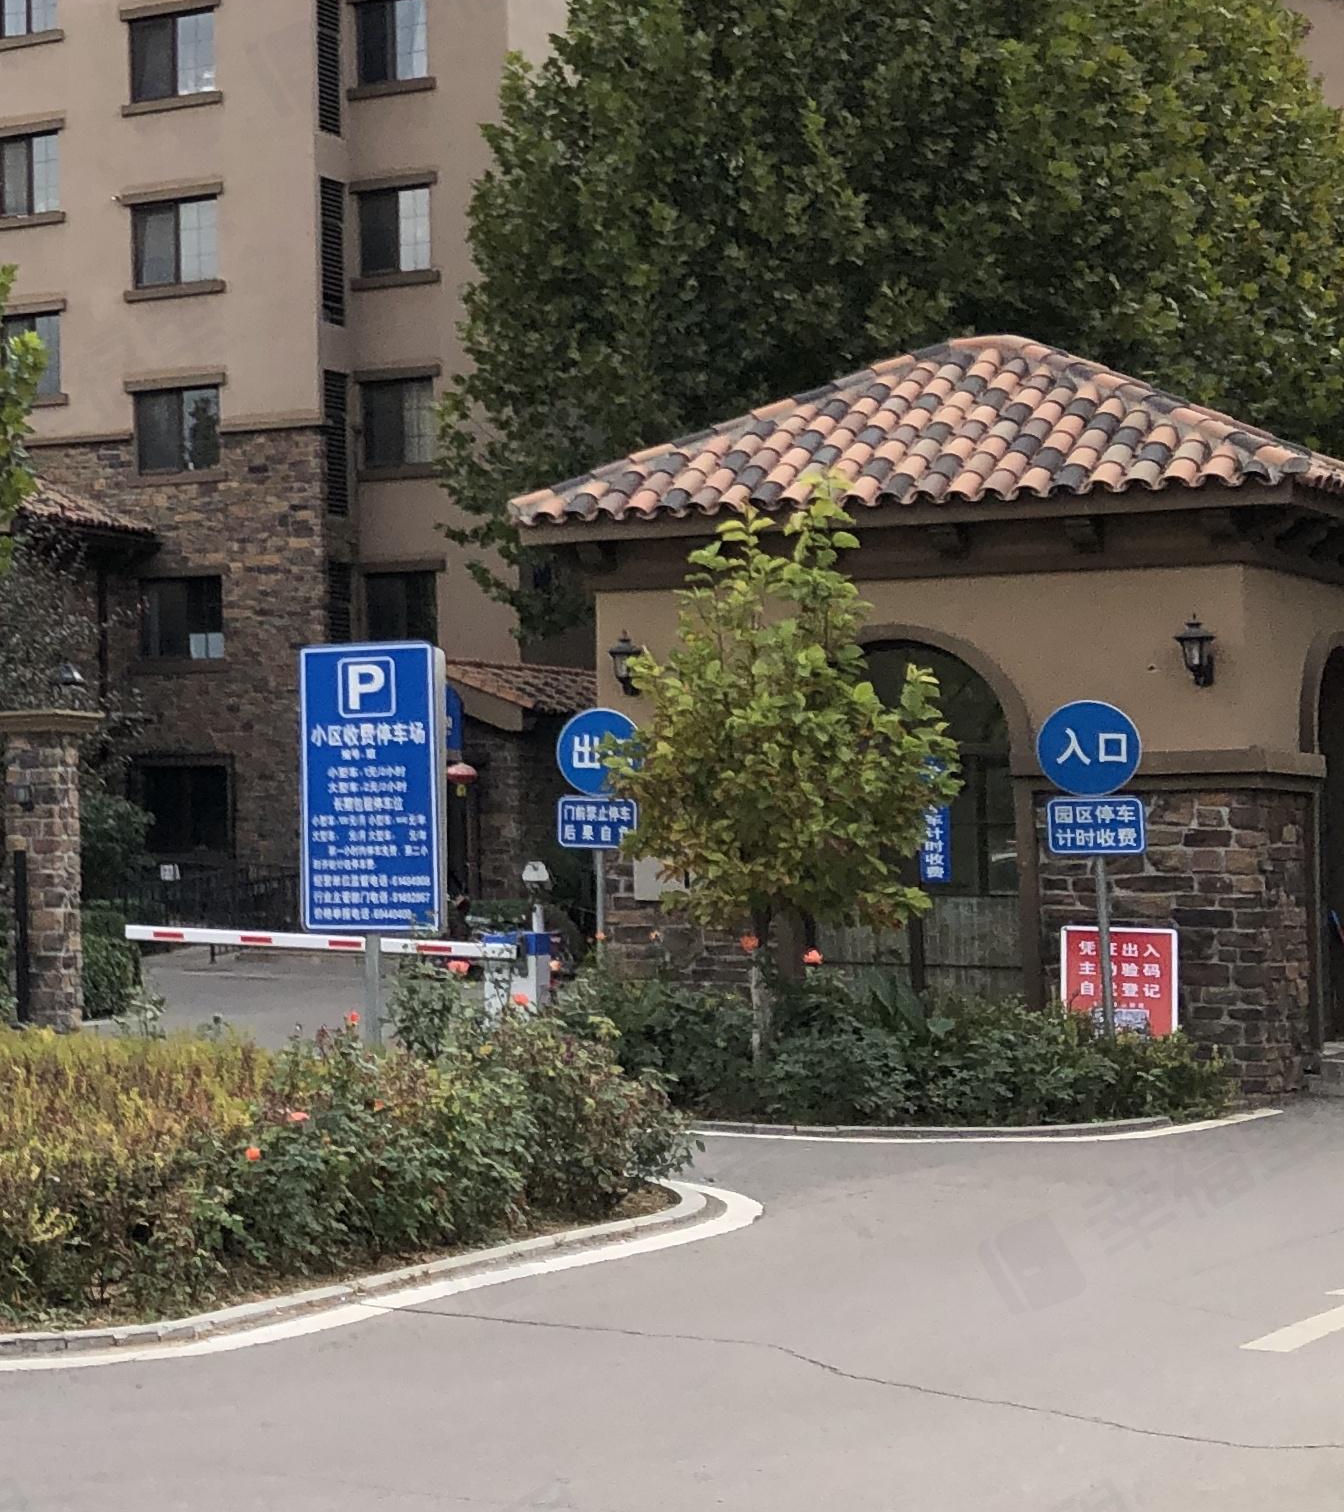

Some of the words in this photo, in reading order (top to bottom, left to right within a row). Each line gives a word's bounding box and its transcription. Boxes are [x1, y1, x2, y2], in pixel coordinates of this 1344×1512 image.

[349, 664, 384, 709] P
[311, 721, 425, 747] 小区收费停车场
[1056, 728, 1127, 765] 入口
[564, 804, 632, 821] 门前禁止停车
[1054, 805, 1136, 823] 园区停车
[924, 805, 944, 879] 车计时收费
[1055, 828, 1137, 847] 计时收费
[1078, 962, 1161, 978] 主验码
[1078, 981, 1161, 999] 自登记
